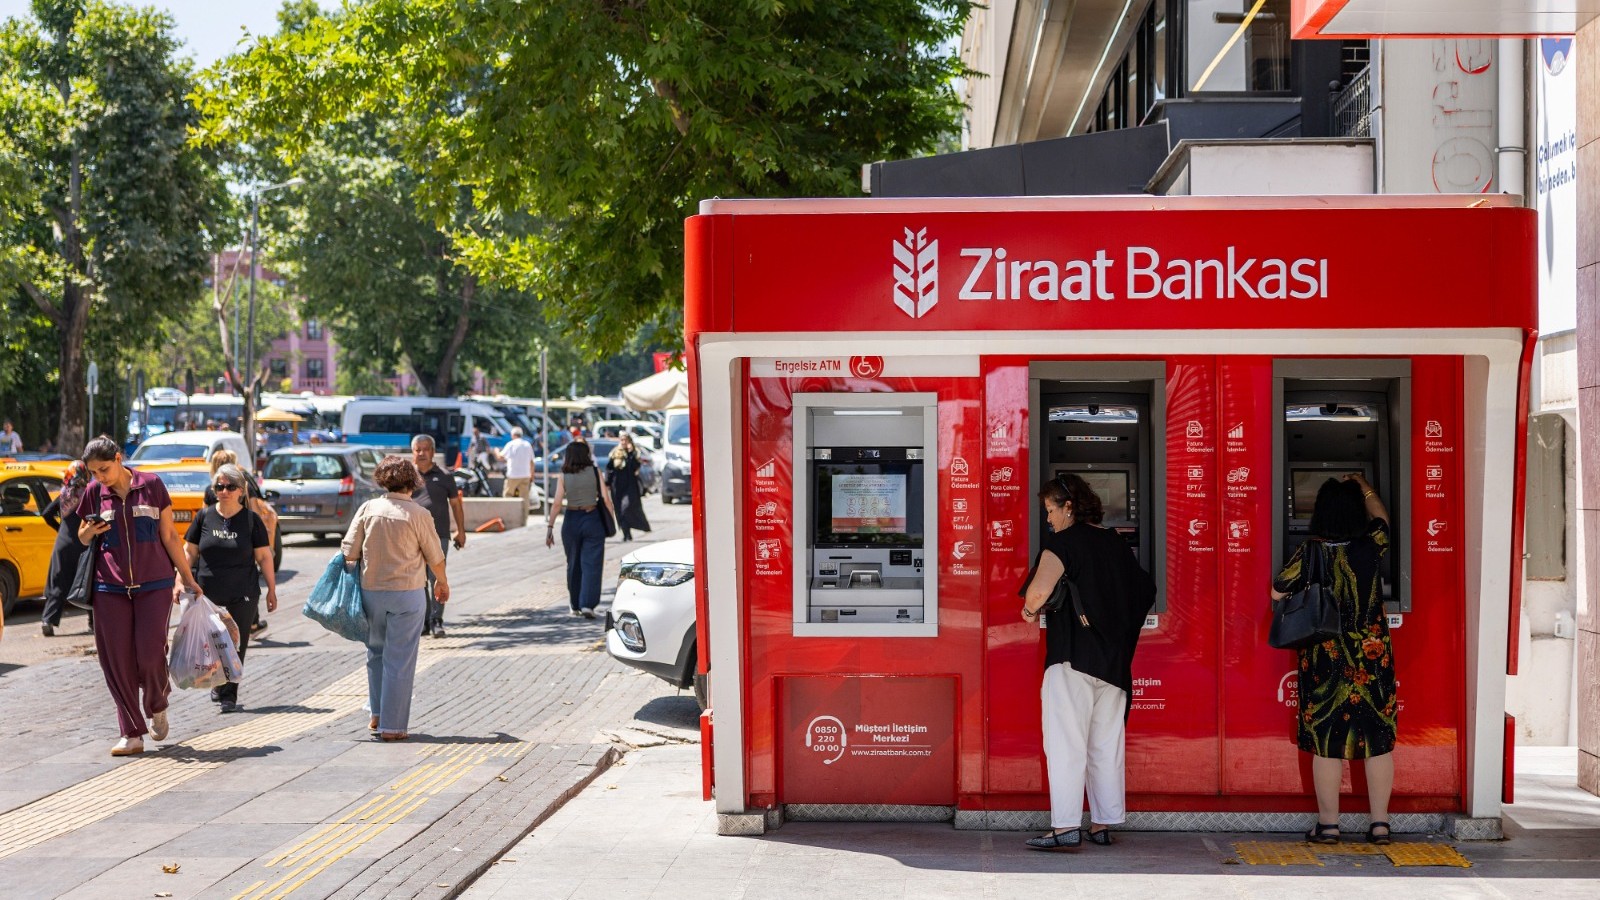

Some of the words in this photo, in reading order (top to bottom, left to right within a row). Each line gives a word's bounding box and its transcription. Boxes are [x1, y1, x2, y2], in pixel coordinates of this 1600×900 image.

[958, 247, 1115, 301] Ziraat
[1126, 245, 1328, 299] Bankası
[775, 360, 817, 373] Engelsiz
[820, 360, 841, 371] ATM
[1132, 678, 1161, 686] etişim
[1287, 681, 1298, 689] 08
[814, 726, 838, 734] 0850
[855, 724, 890, 733] Müşteri
[892, 722, 928, 734] İletişim
[818, 735, 835, 743] 220
[873, 734, 910, 743] Merkezi
[813, 744, 826, 752] 00
[827, 744, 839, 752] 00
[851, 748, 932, 756] www.ziraatbank.com.tr
